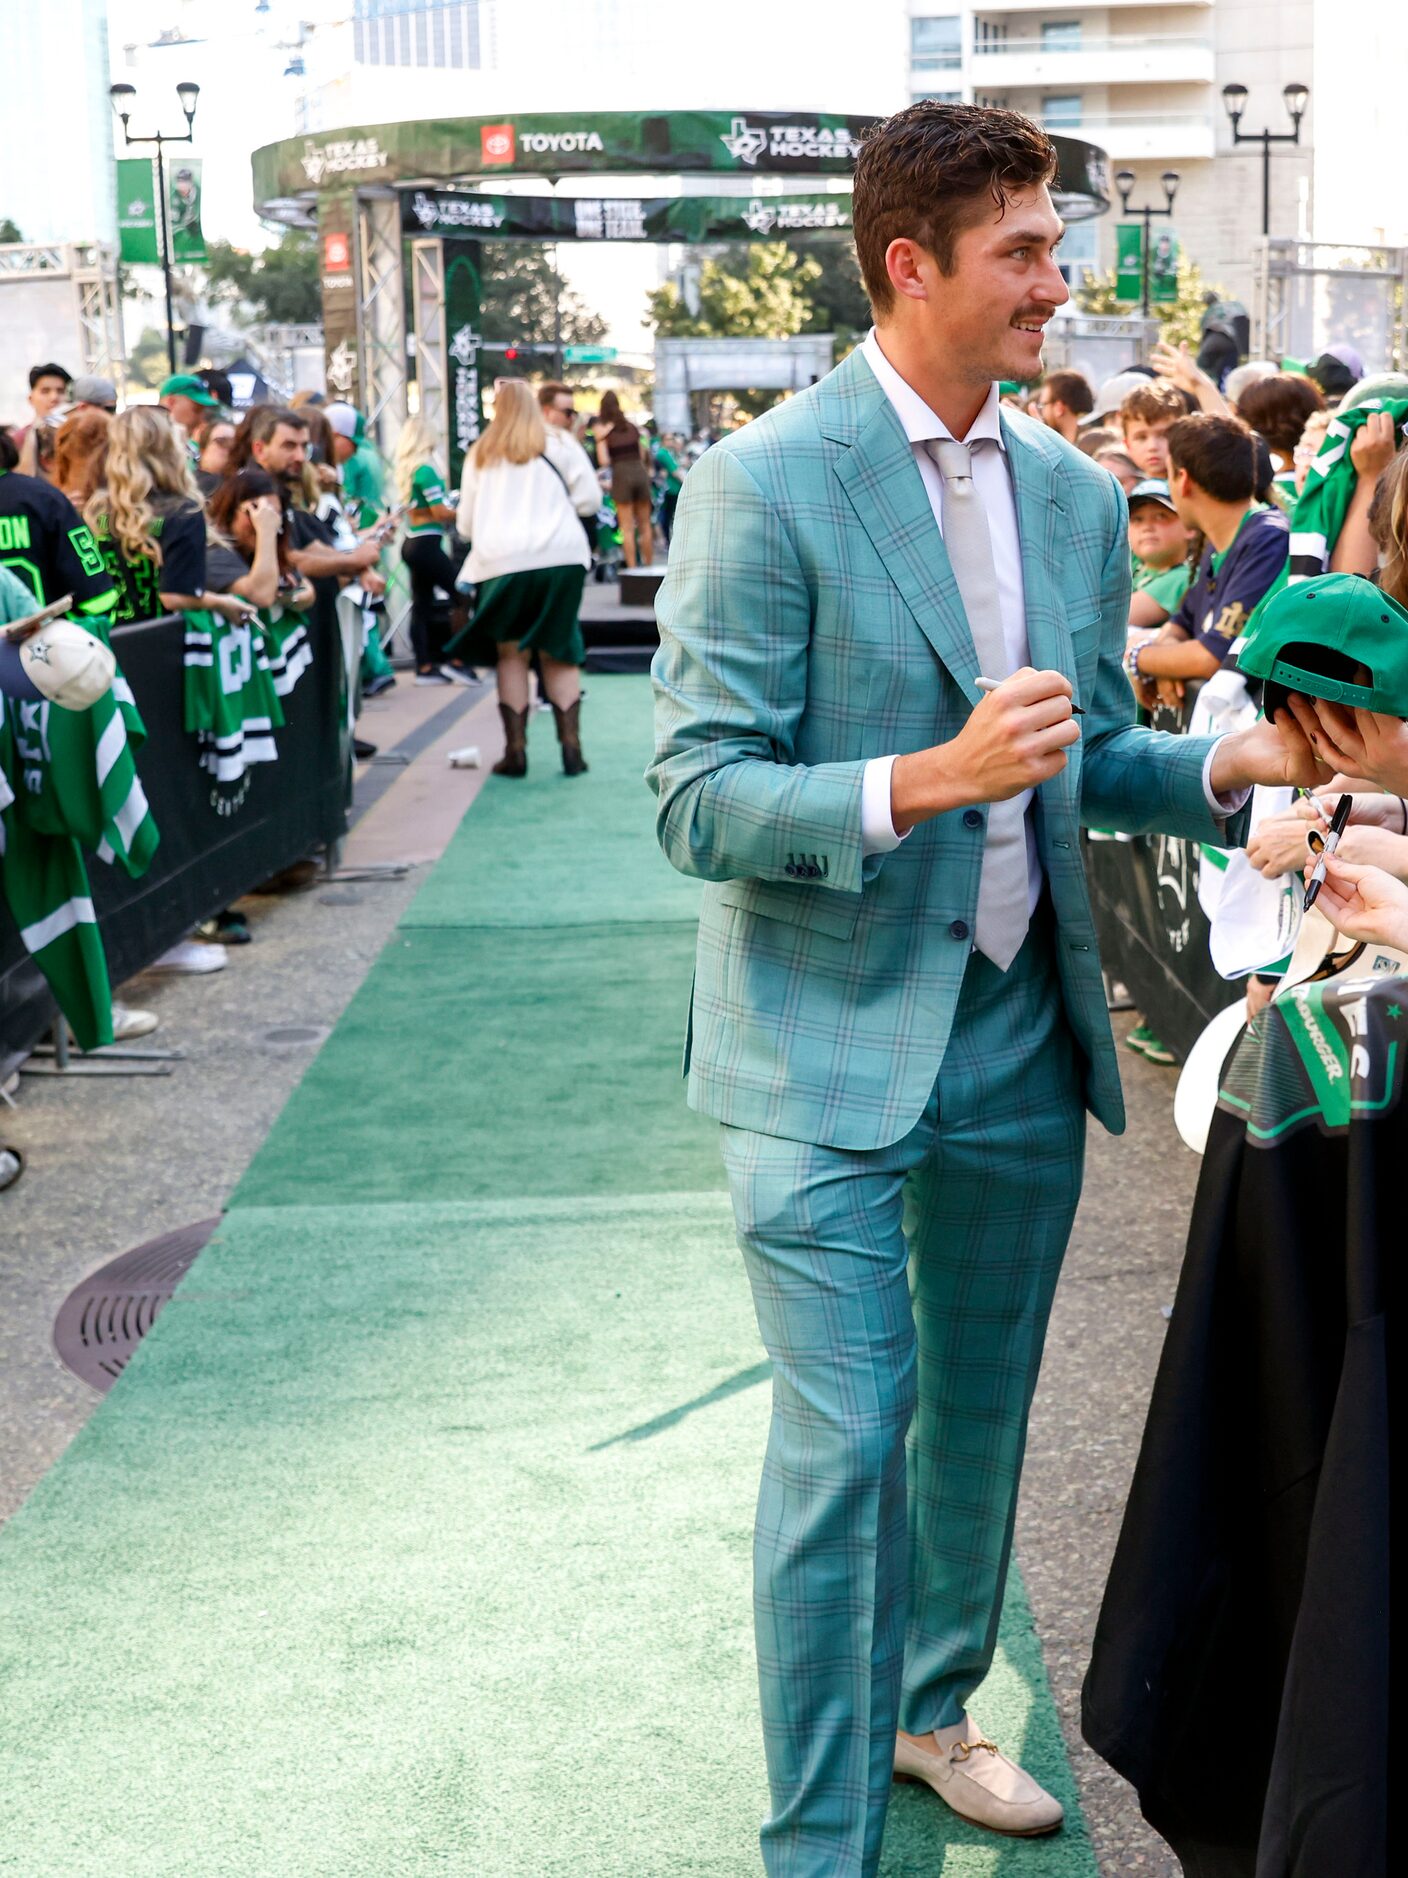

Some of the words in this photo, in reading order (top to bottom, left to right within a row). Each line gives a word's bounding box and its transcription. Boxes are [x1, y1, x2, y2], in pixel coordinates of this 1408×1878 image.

[519, 133, 603, 152] TOYOTA
[770, 126, 850, 143] TEXAS
[324, 137, 379, 157] TEXAS
[770, 142, 861, 158] HOCKEY
[324, 151, 388, 173] HOCKEY
[438, 202, 495, 217] TEXAS
[778, 203, 840, 217] TEXAS
[777, 214, 849, 228] HOCKEY
